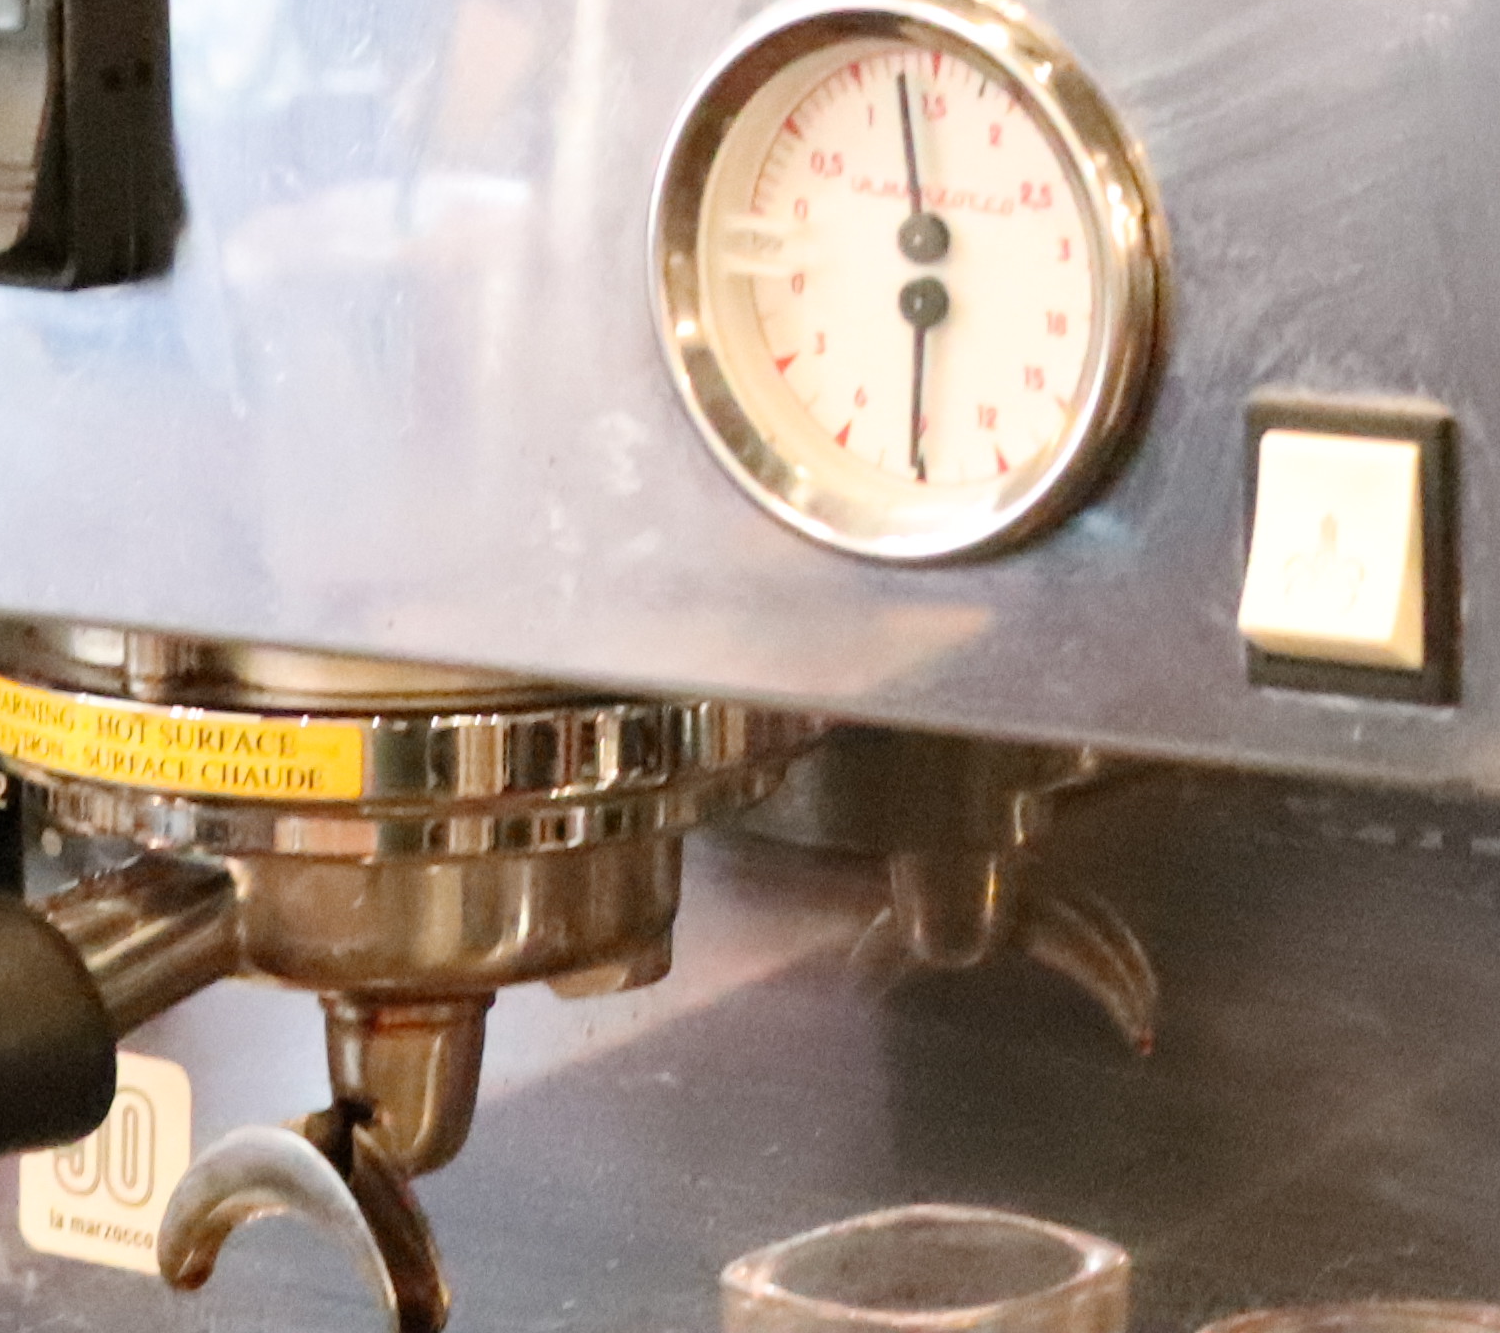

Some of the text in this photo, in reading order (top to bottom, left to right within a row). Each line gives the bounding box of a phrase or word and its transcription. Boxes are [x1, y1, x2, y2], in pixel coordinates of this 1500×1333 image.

[97, 714, 147, 745] HOT
[159, 722, 297, 757] SURFACE
[83, 745, 190, 781] SURFACE
[201, 762, 325, 791] CHAUDE
